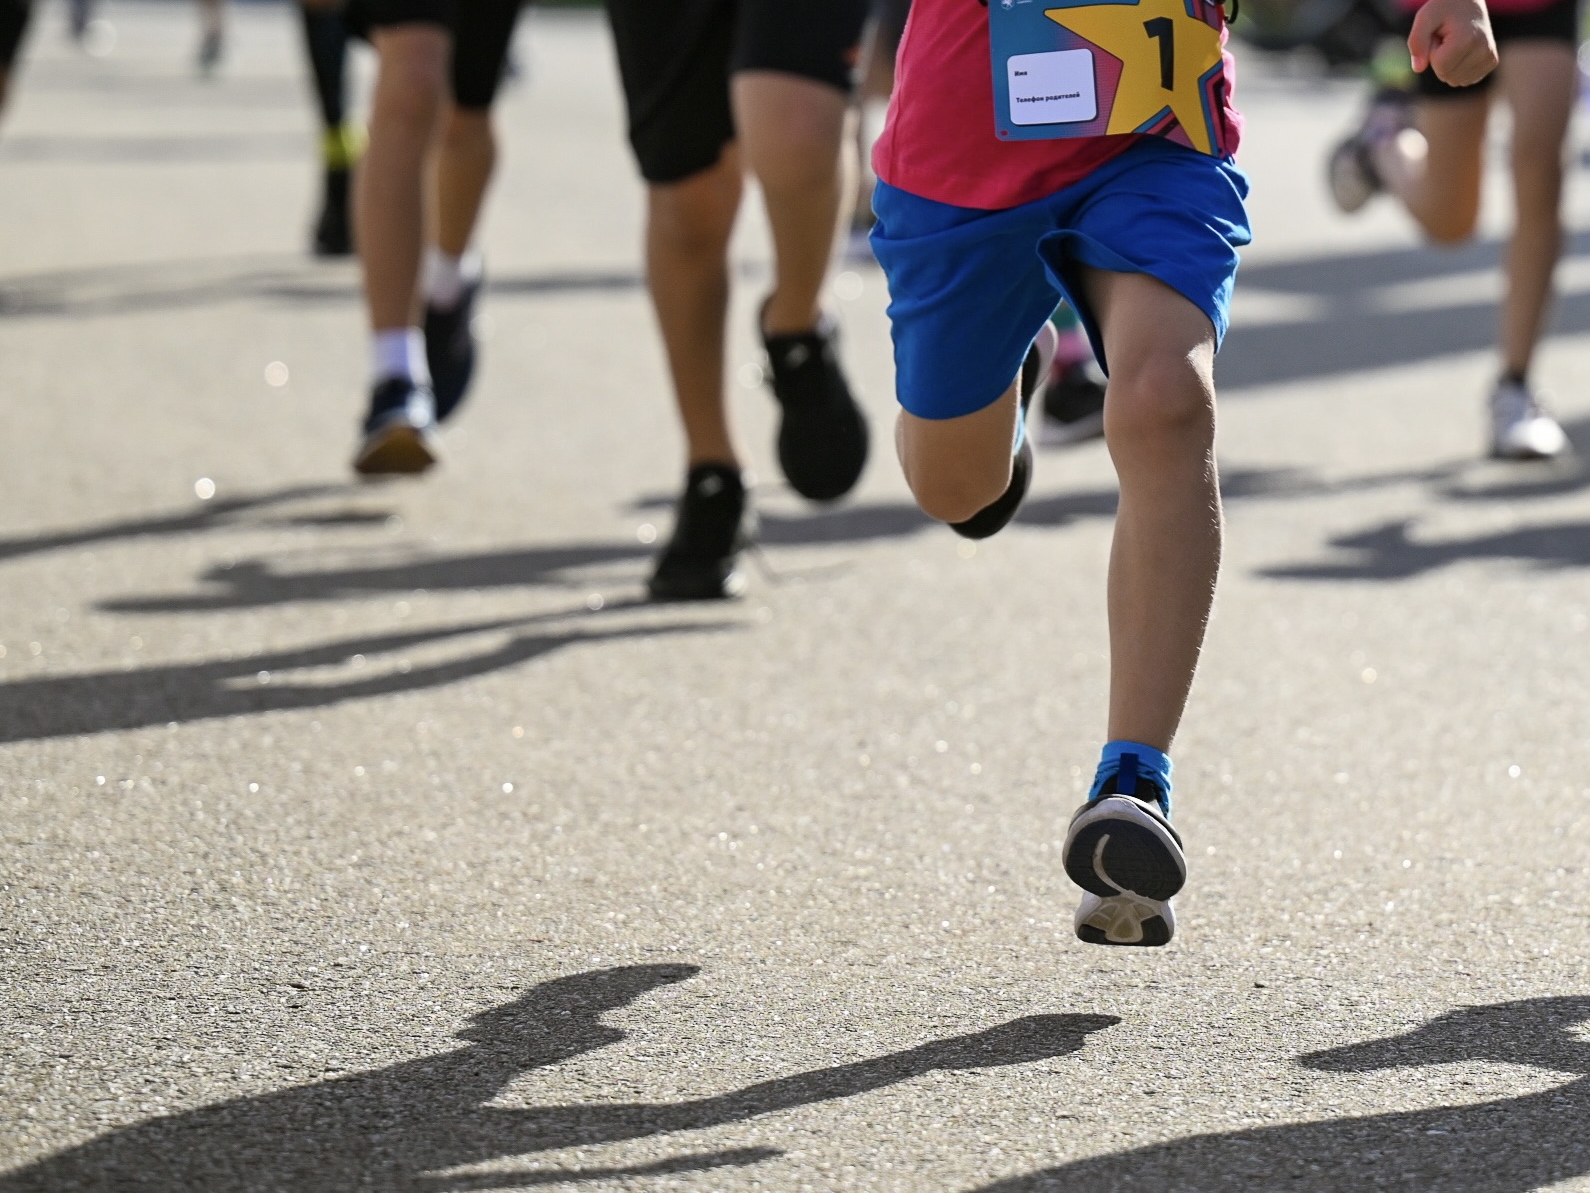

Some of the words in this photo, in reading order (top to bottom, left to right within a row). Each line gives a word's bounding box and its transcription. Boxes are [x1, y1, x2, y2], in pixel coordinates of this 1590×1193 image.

[1143, 16, 1174, 92] 1
[1016, 96, 1044, 104] Телефон
[1045, 91, 1080, 102] родителей
